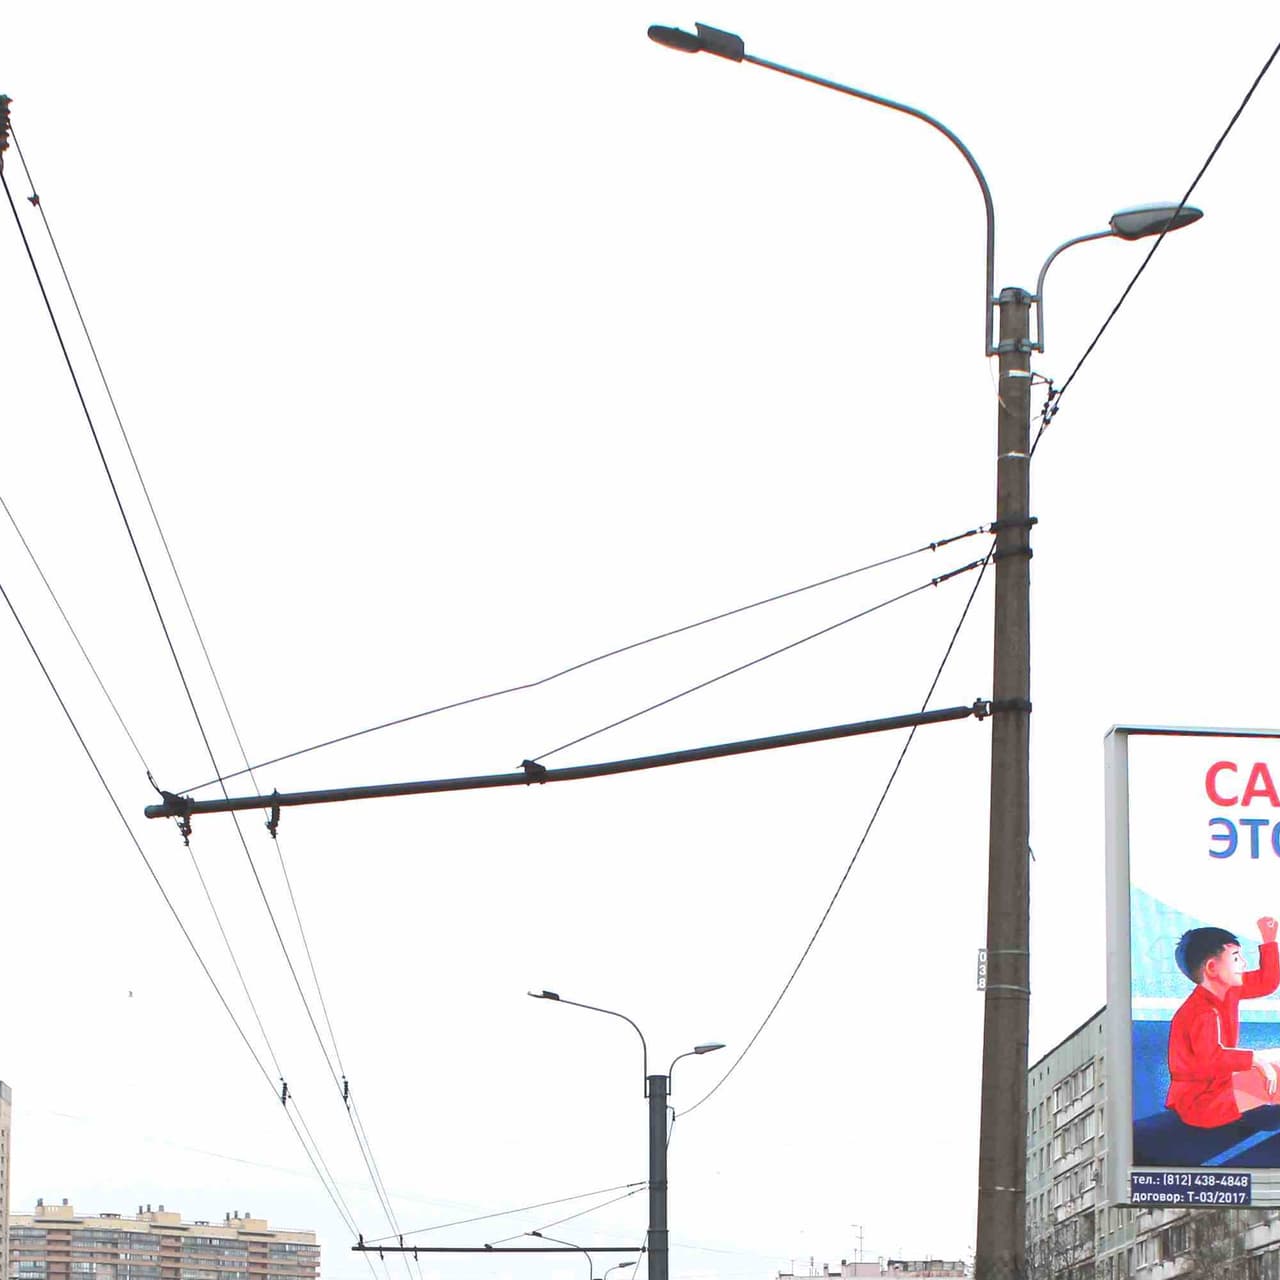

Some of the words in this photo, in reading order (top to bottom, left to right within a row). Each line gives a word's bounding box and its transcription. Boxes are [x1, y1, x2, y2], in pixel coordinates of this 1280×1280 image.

[1132, 1175, 1160, 1185] тел.:
[1163, 1174, 1192, 1186] (812)
[1194, 1175, 1248, 1187] 438-4848
[1132, 1192, 1184, 1204] договор:
